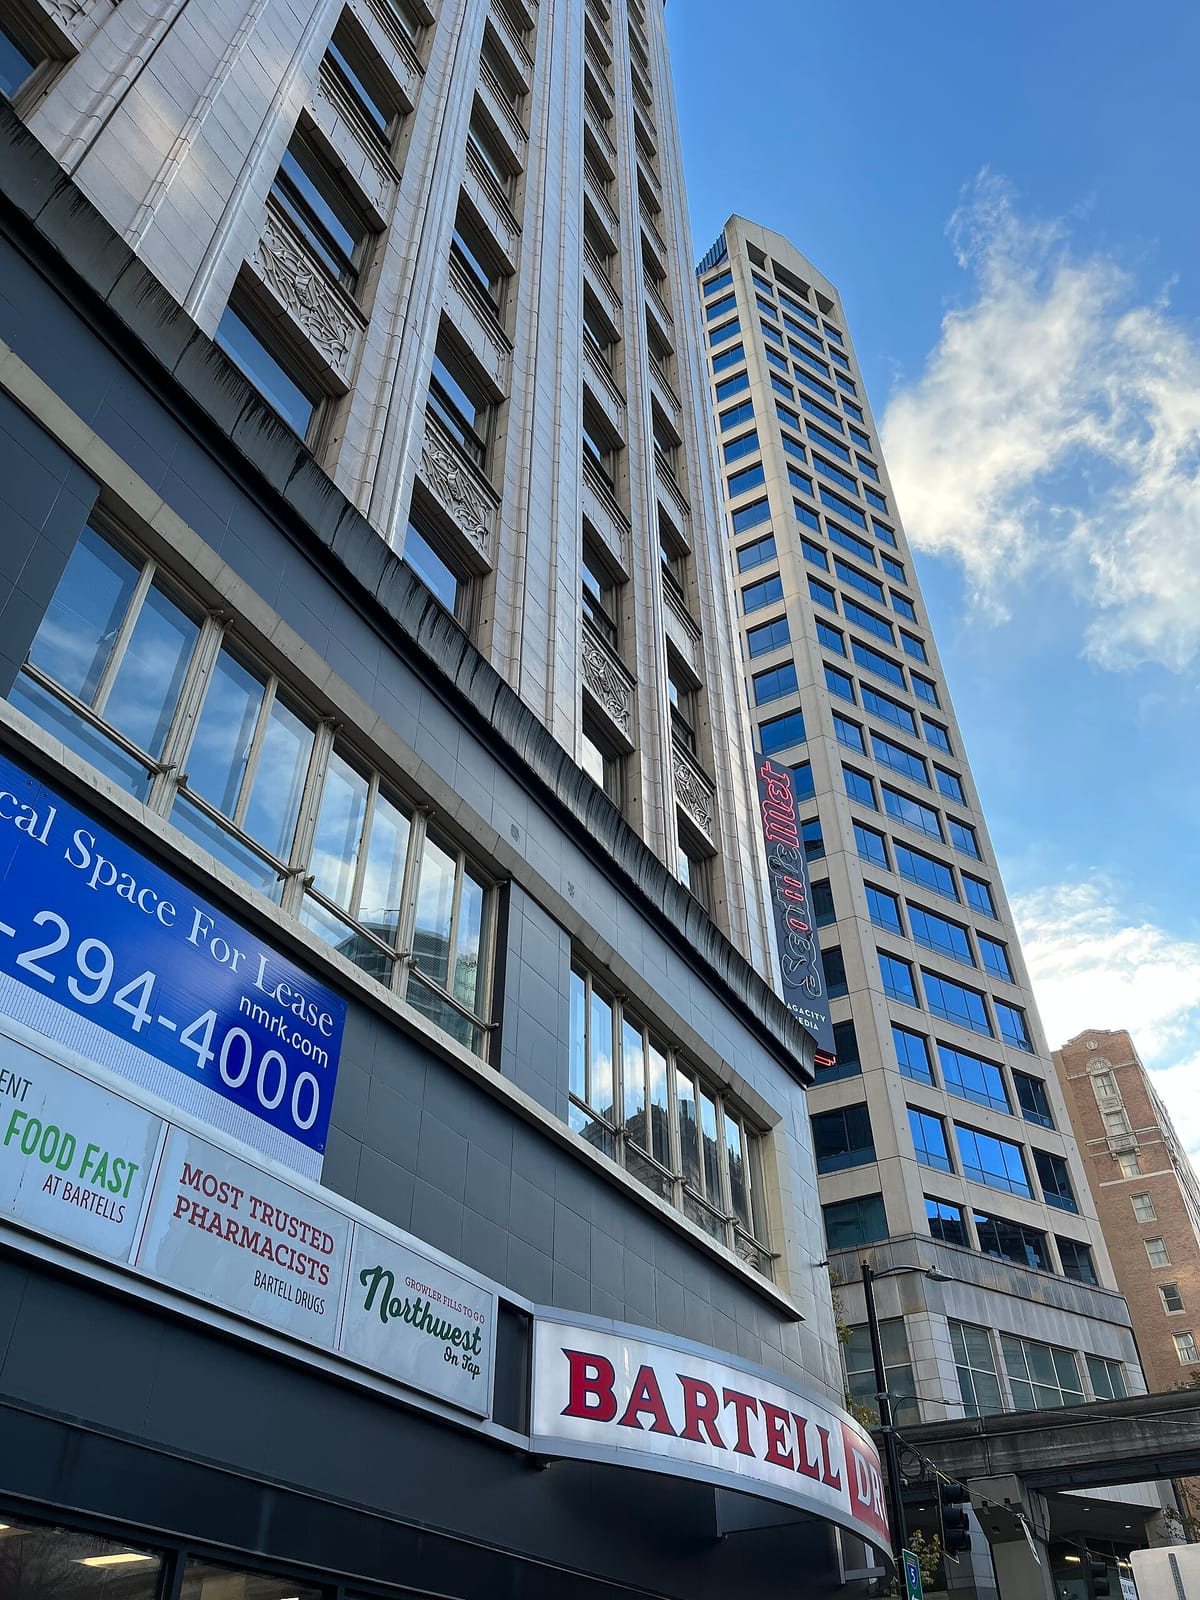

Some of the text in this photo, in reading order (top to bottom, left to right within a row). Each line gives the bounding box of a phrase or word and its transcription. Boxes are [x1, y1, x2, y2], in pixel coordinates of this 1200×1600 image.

[760, 760, 822, 998] Seattle Met
[63, 829, 177, 928] Space
[185, 906, 246, 974] For
[252, 952, 334, 1037] Lease
[238, 995, 329, 1069] nmrk.com
[786, 1002, 826, 1023] AGACITY
[796, 1016, 819, 1031] EDIA
[3, 1109, 140, 1198] FOOD FAST
[42, 1174, 126, 1224] AT BARTELLS
[179, 1162, 334, 1255] MOST TRUSTED
[173, 1194, 330, 1286] PHARMACISTS
[254, 1269, 326, 1315] BARTELL DRUGS
[359, 1265, 482, 1355] Northwest
[405, 1276, 485, 1324] GROWLER FILLS TO GO
[443, 1346, 481, 1380] On Tap
[560, 1347, 842, 1492] BARTELL
[910, 1567, 916, 1584] 5
